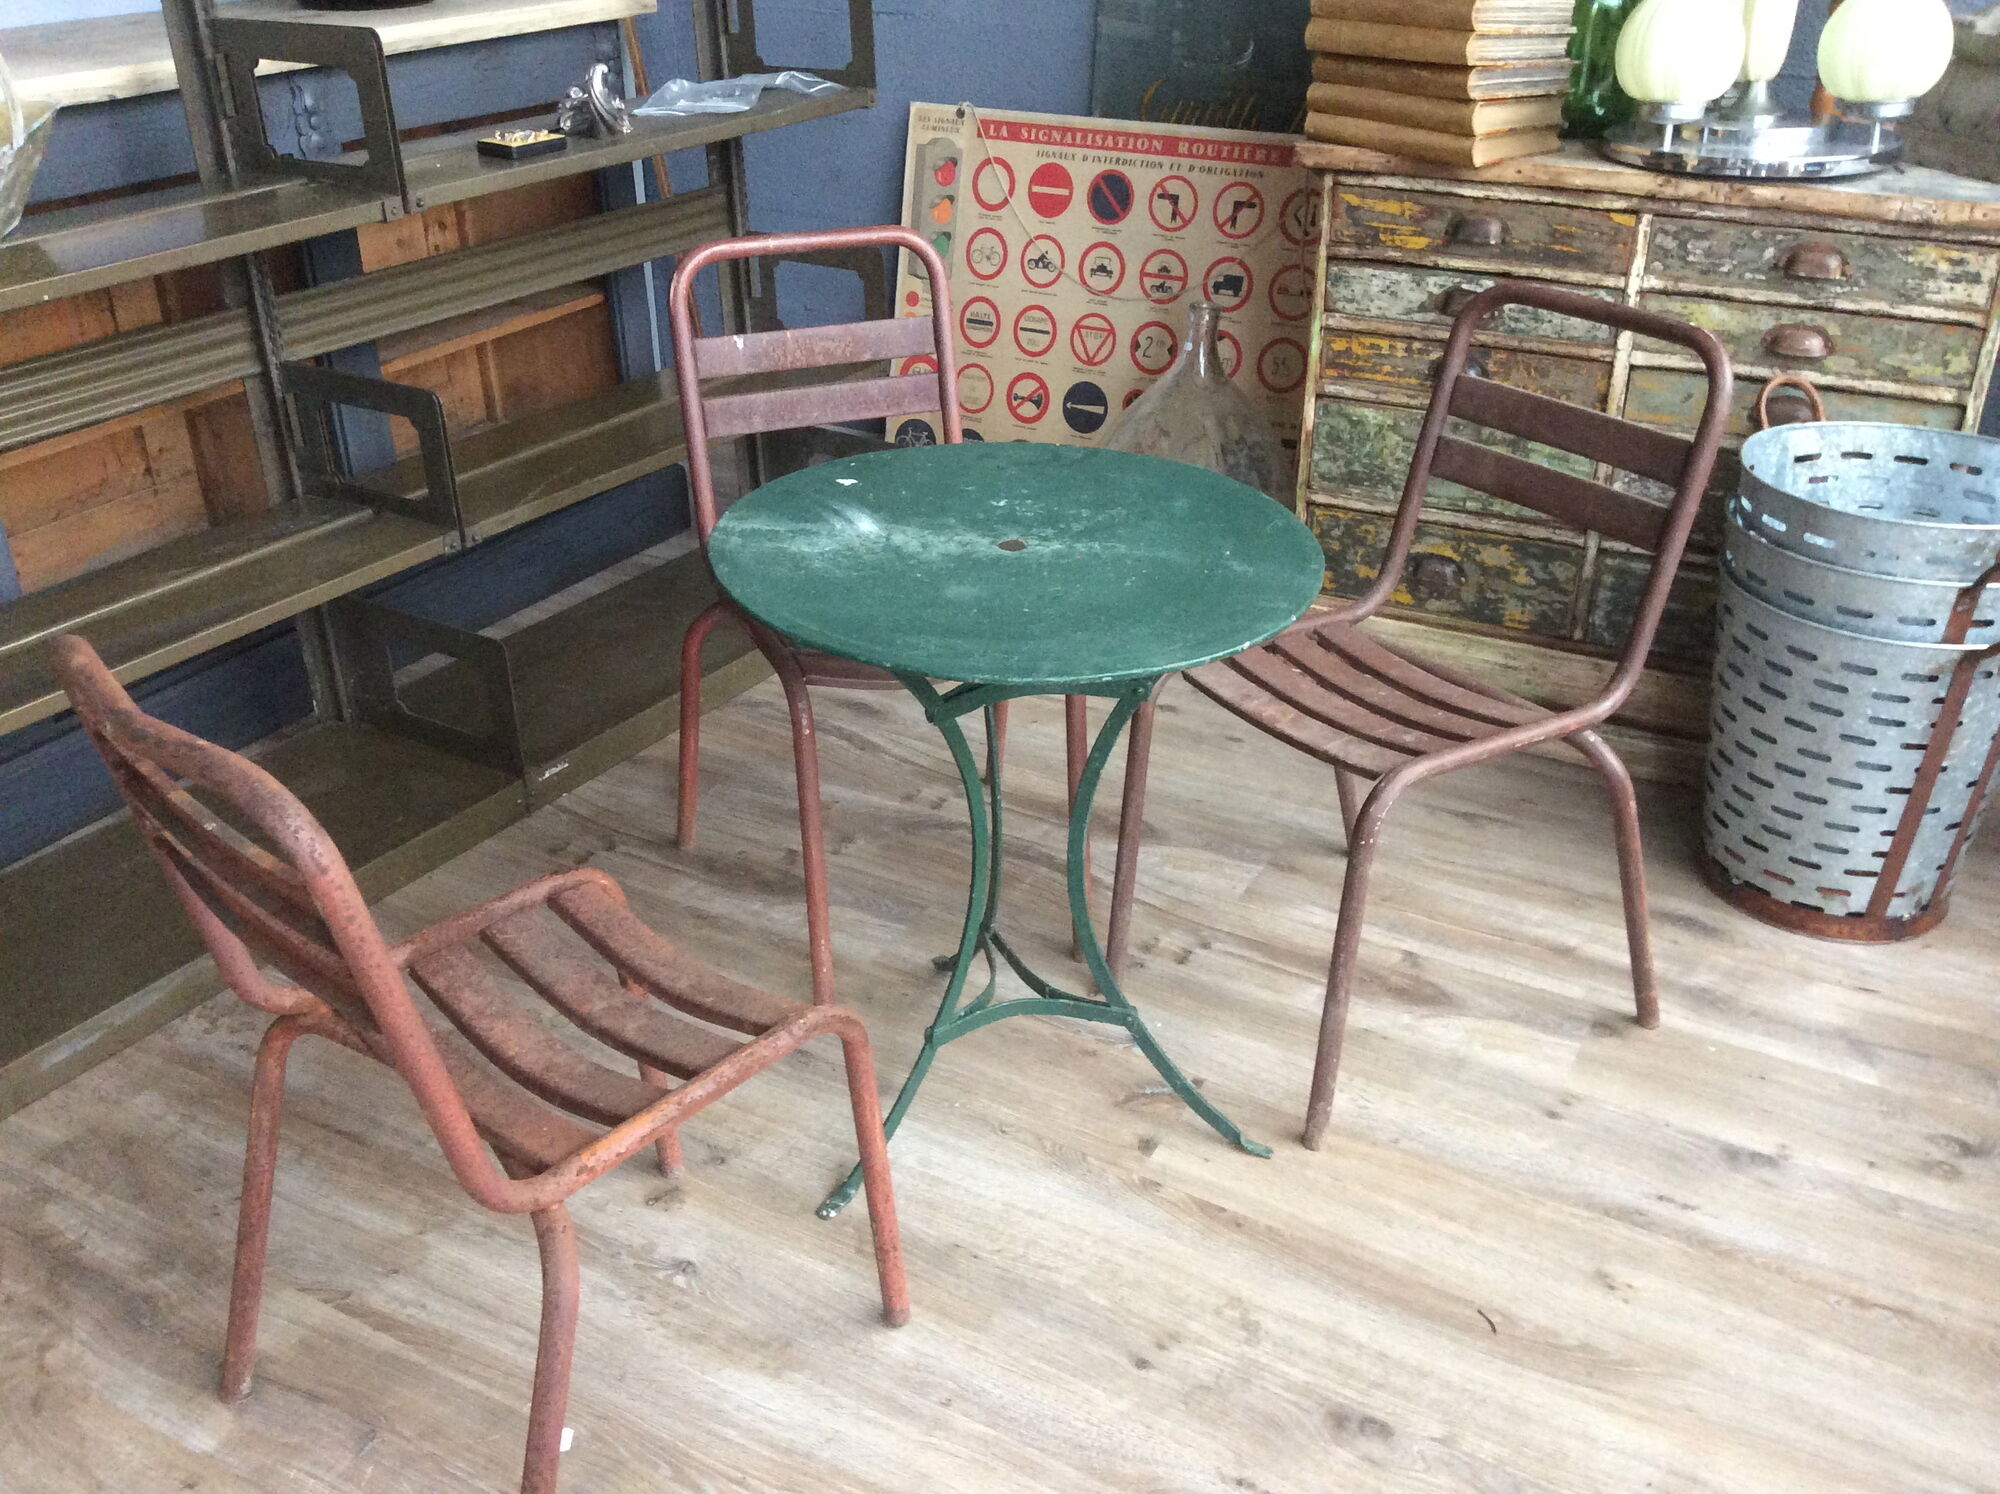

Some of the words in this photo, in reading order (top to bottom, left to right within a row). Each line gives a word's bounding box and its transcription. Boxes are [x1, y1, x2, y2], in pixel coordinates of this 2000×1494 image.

[989, 123, 1009, 138] LA
[1020, 127, 1164, 152] SIGNALISATION
[1036, 149, 1077, 161] SIGNAUX
